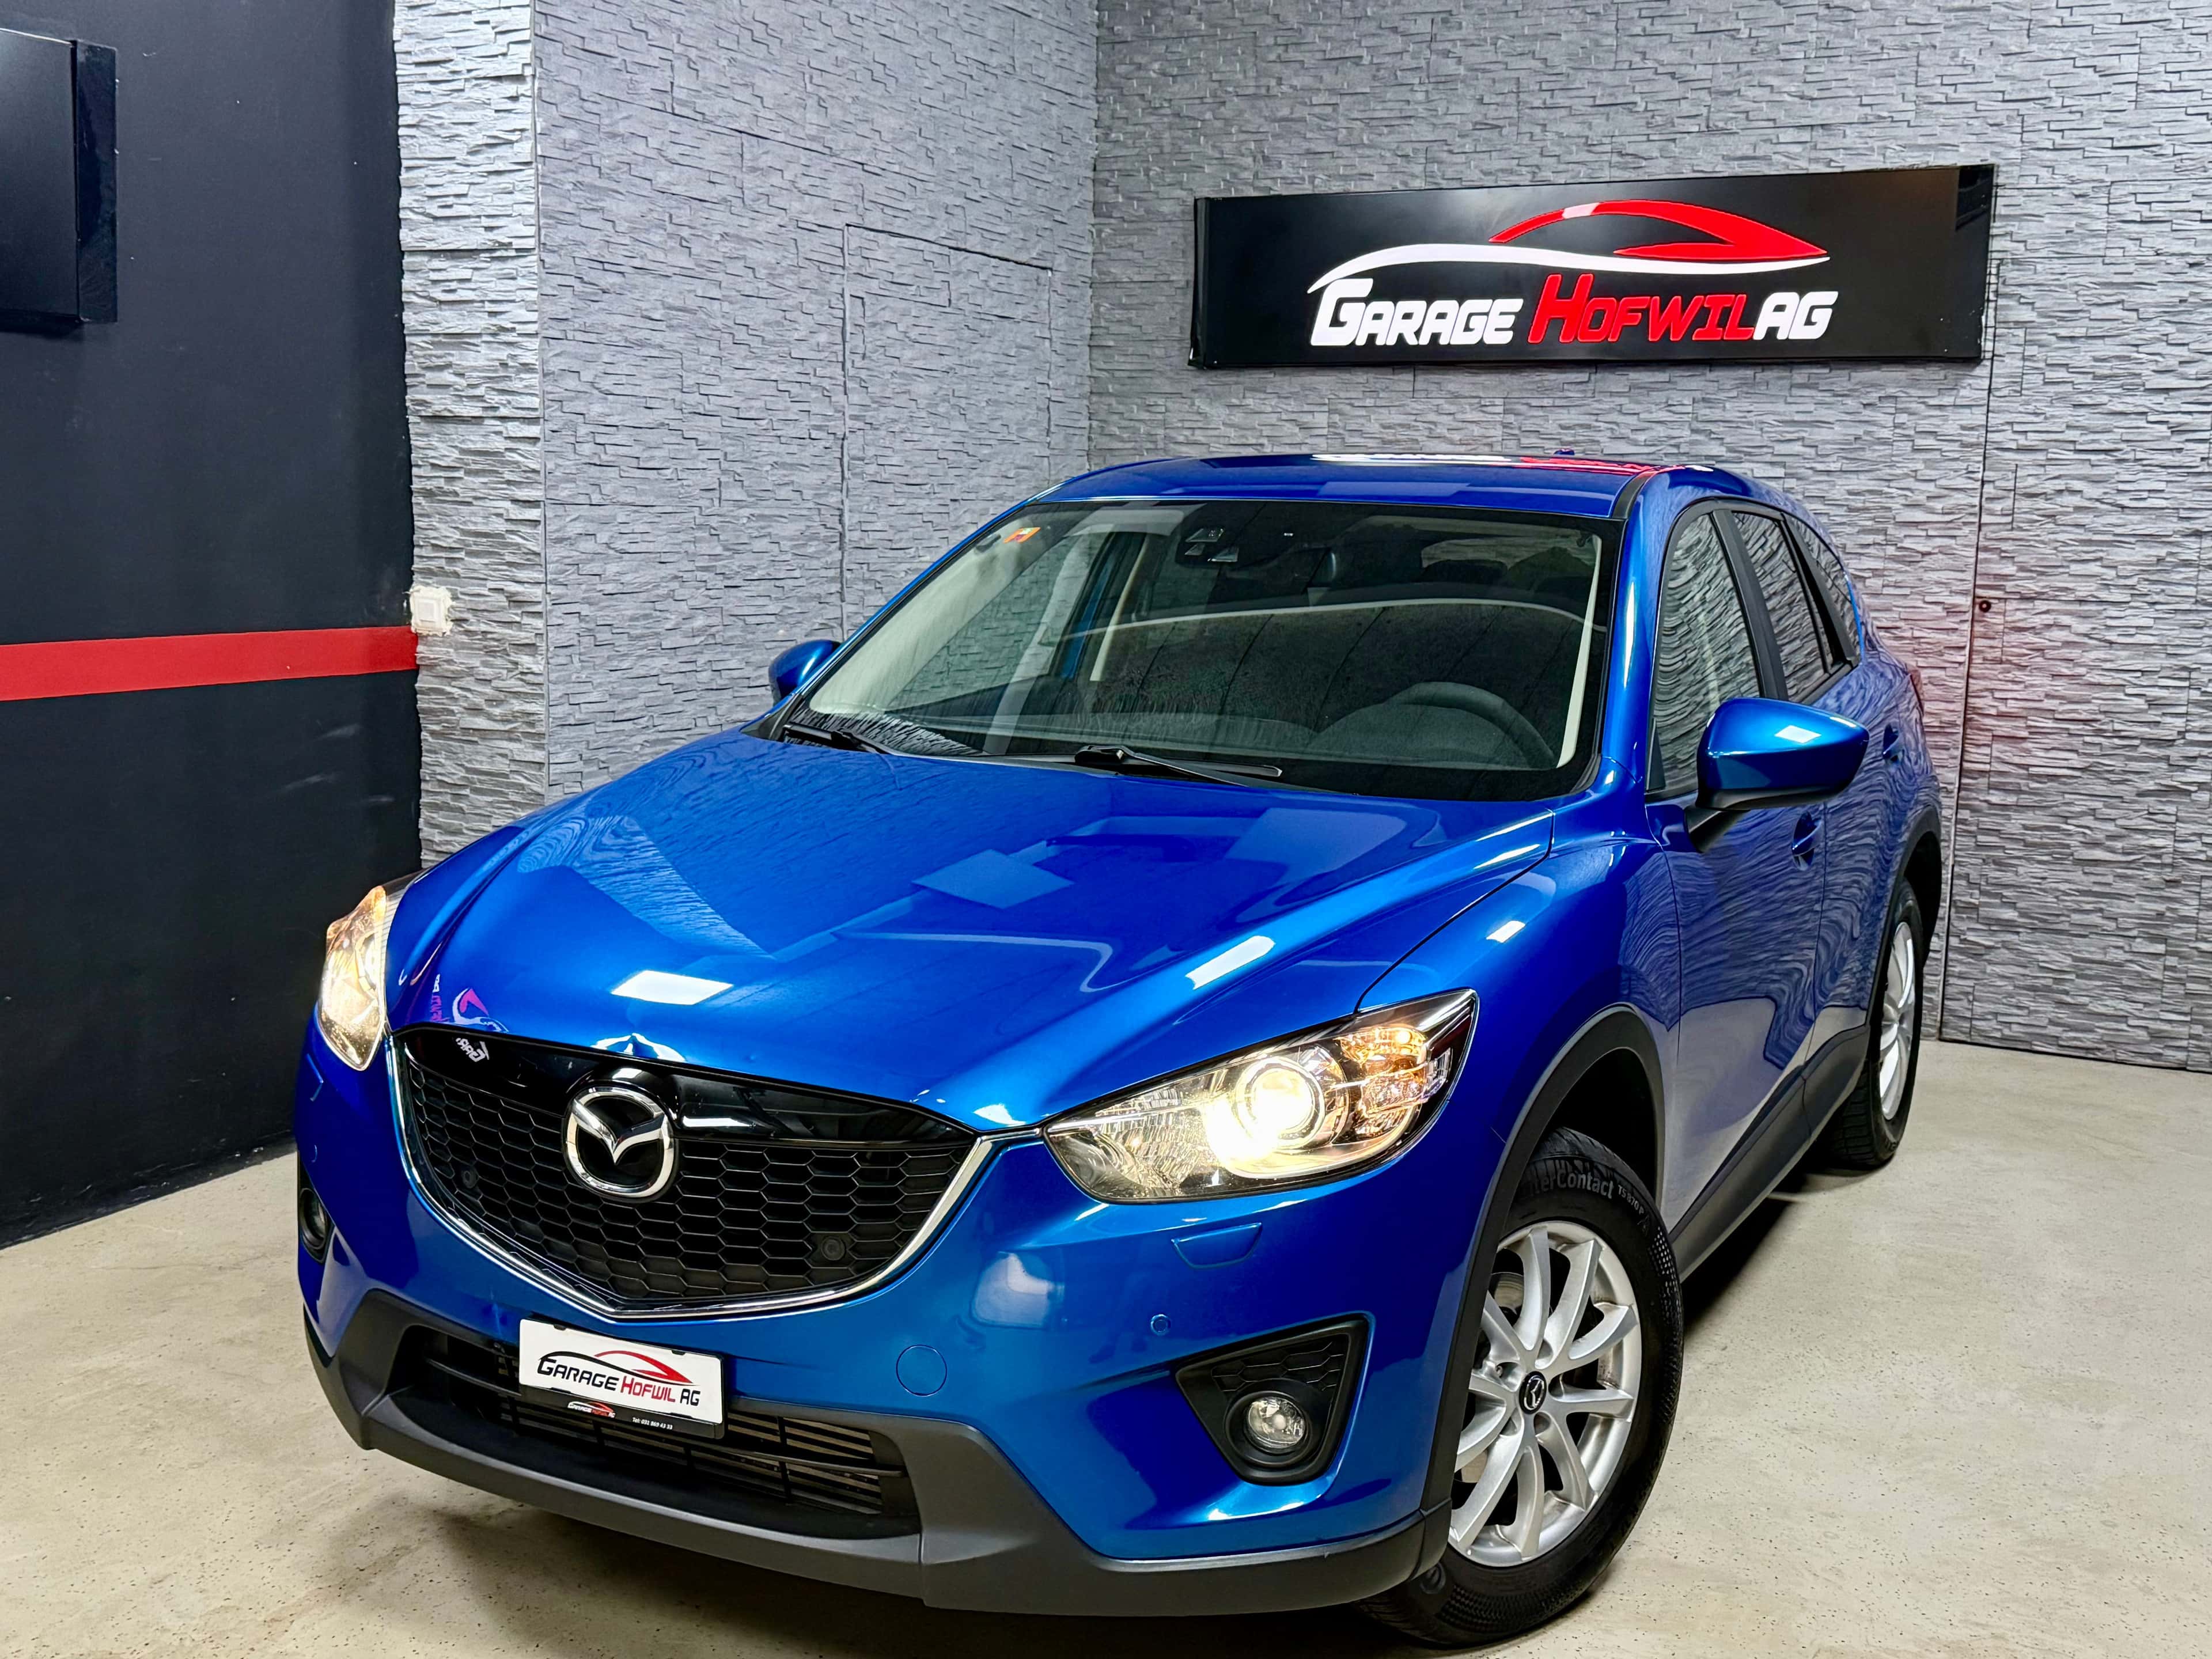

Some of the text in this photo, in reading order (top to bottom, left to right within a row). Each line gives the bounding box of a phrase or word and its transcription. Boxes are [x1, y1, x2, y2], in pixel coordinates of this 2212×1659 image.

[1310, 272, 1839, 346] GARAGE HOFWIL AG
[537, 1358, 701, 1407] GARAGE HOFWIL AG
